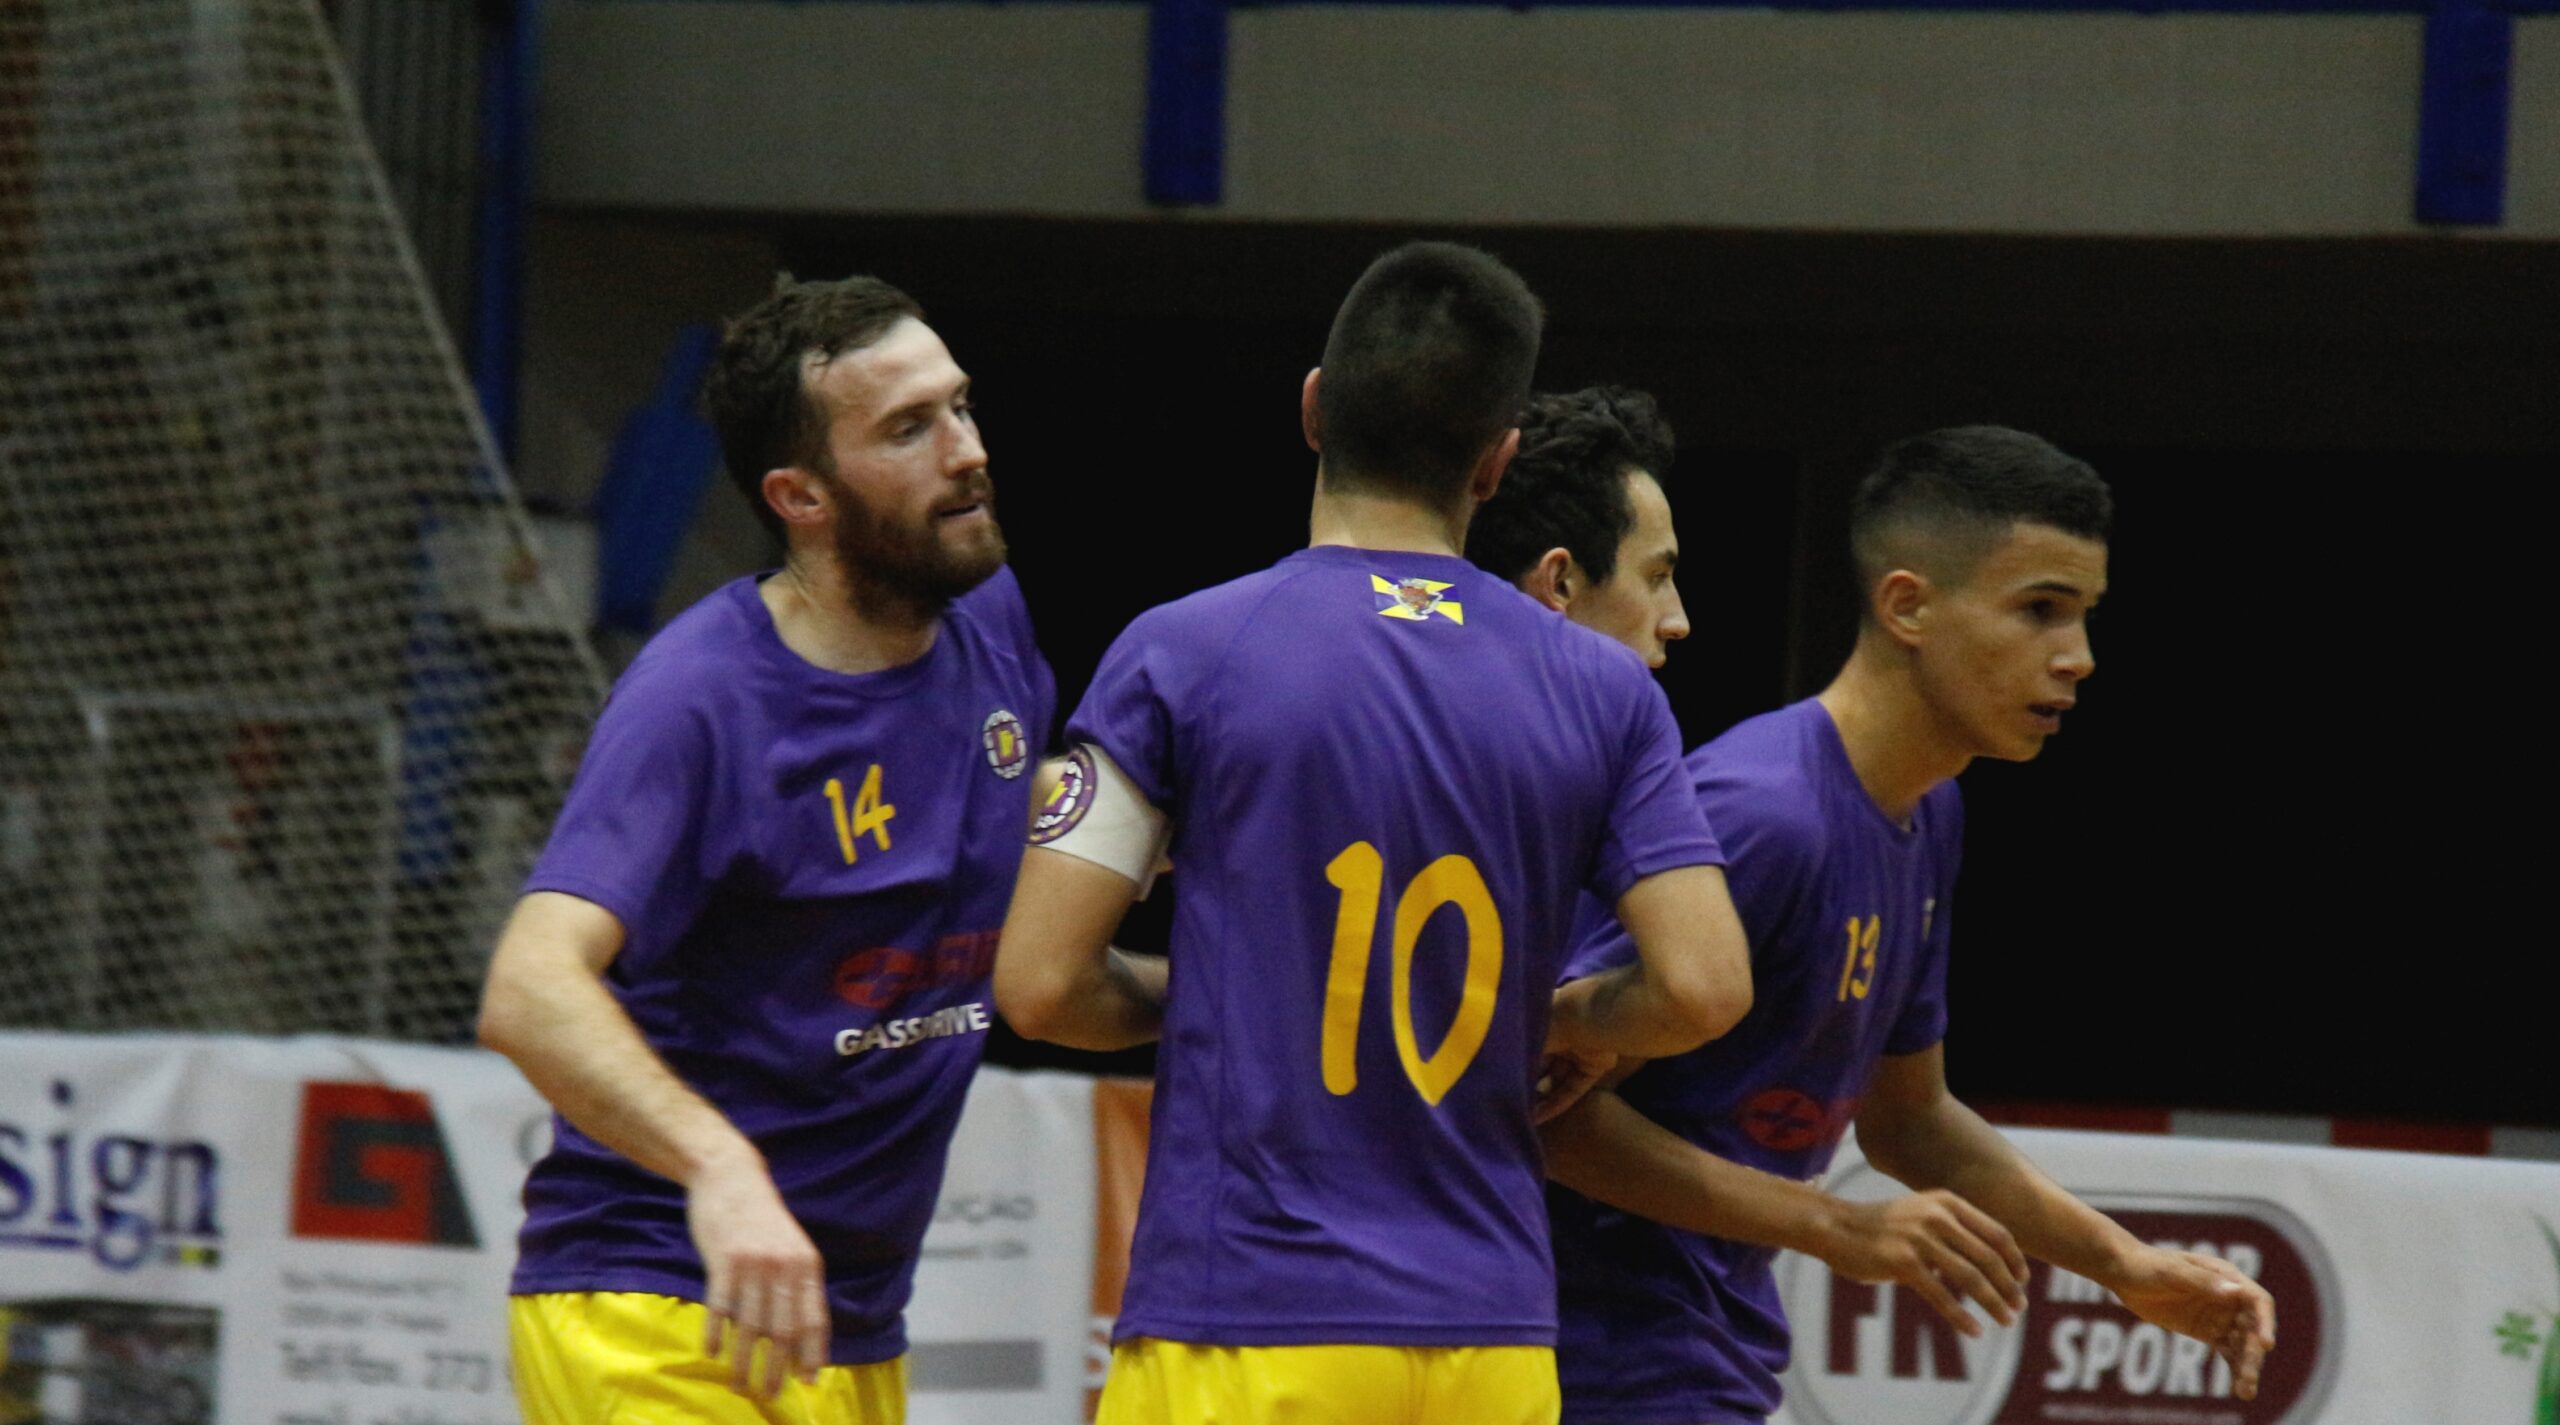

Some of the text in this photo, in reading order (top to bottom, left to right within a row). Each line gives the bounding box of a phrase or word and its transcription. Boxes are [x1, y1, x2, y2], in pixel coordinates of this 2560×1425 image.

[824, 764, 896, 866] 14
[1321, 841, 1503, 1106] 10
[1838, 914, 1880, 1001] 13
